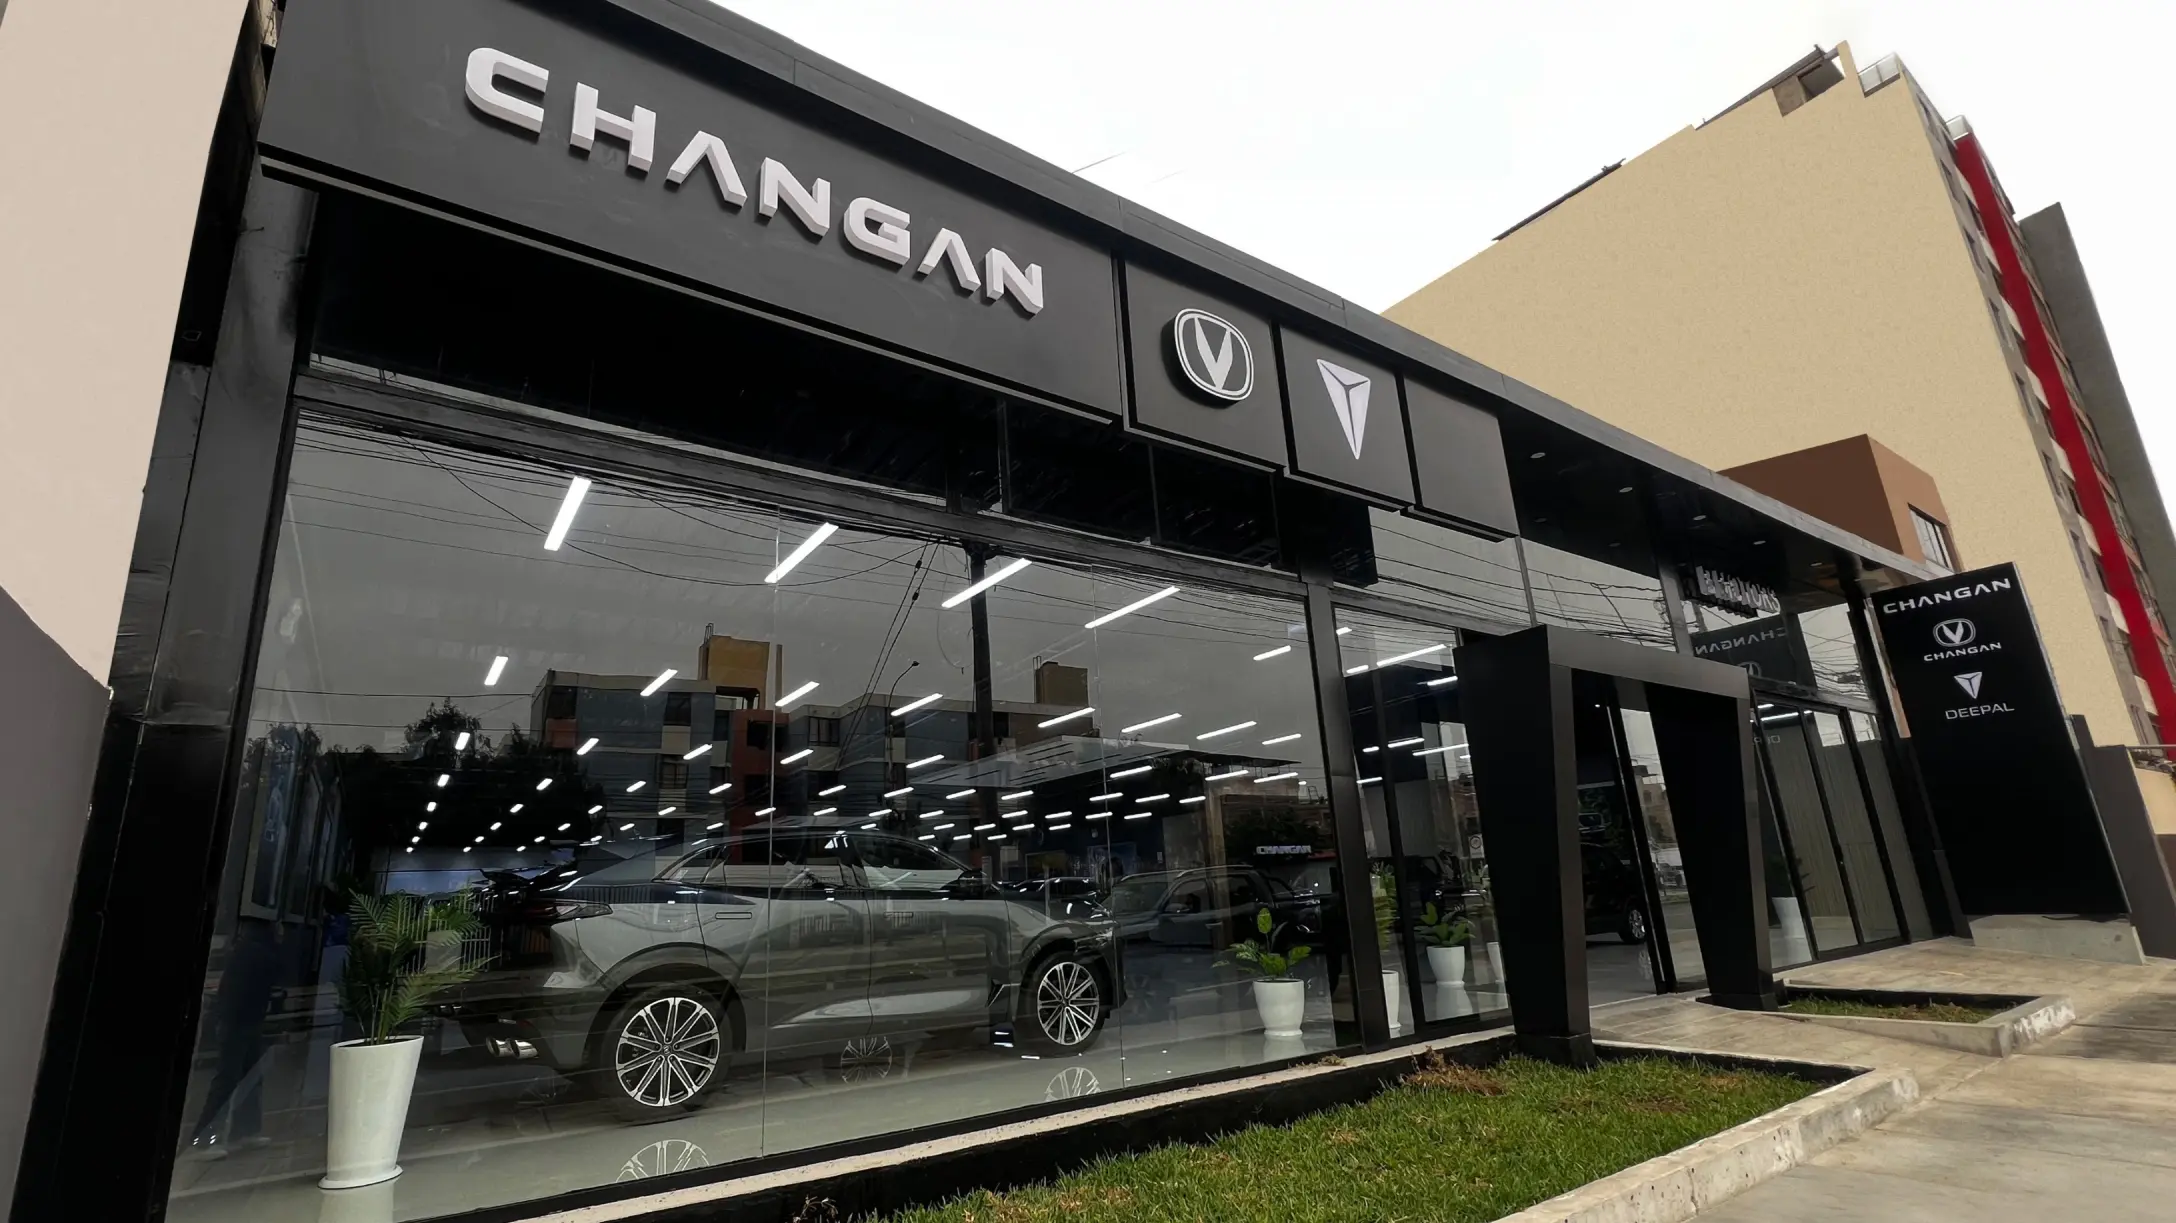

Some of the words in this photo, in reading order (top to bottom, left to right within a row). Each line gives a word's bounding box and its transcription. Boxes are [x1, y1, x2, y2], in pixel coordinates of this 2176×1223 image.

[464, 47, 1045, 316] CHANGAN
[1882, 577, 2012, 614] CHANGAN
[1923, 641, 2002, 662] CHANGAN
[1945, 702, 2015, 720] DEEPAL
